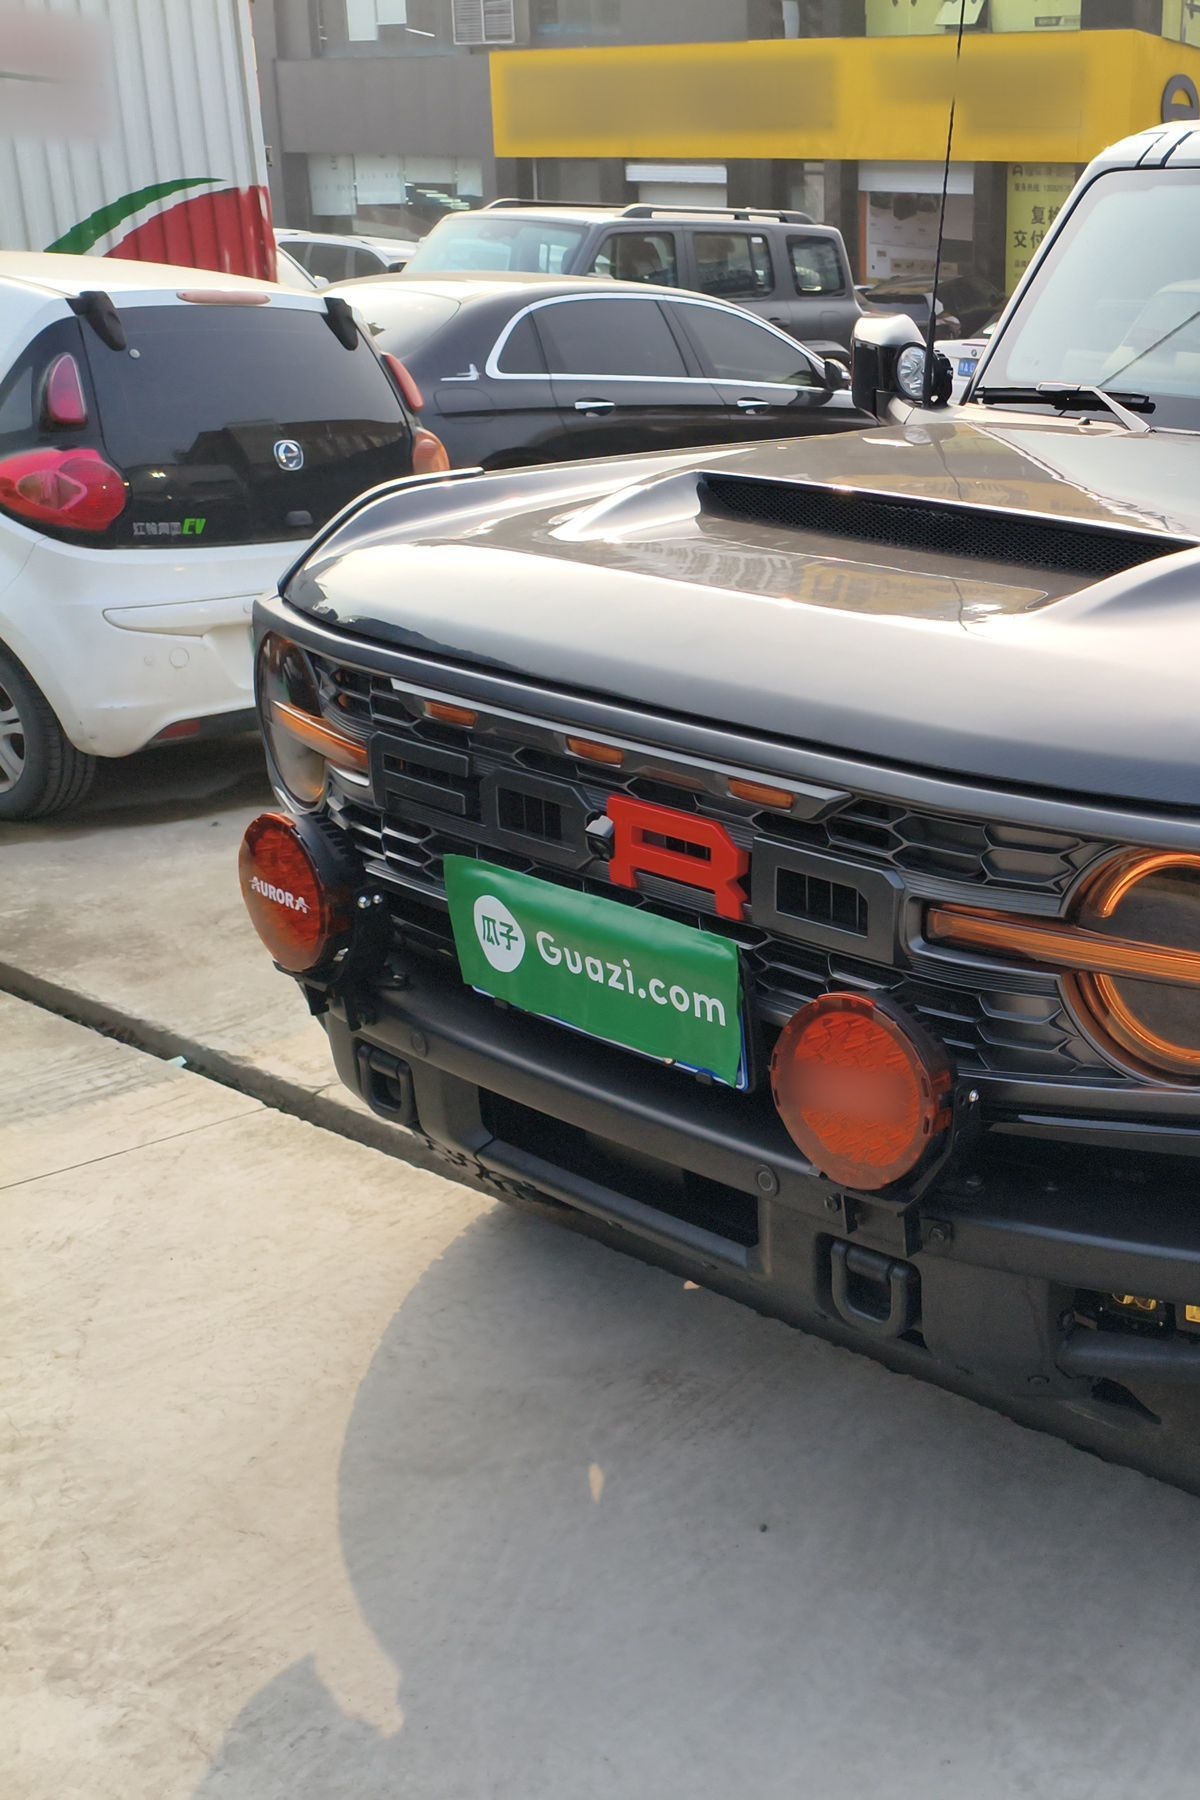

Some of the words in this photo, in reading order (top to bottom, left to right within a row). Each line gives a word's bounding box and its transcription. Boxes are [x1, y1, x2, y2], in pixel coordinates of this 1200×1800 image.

[249, 876, 312, 914] AURORA
[481, 913, 519, 951] 瓜子
[535, 930, 727, 1027] Guazi.com
